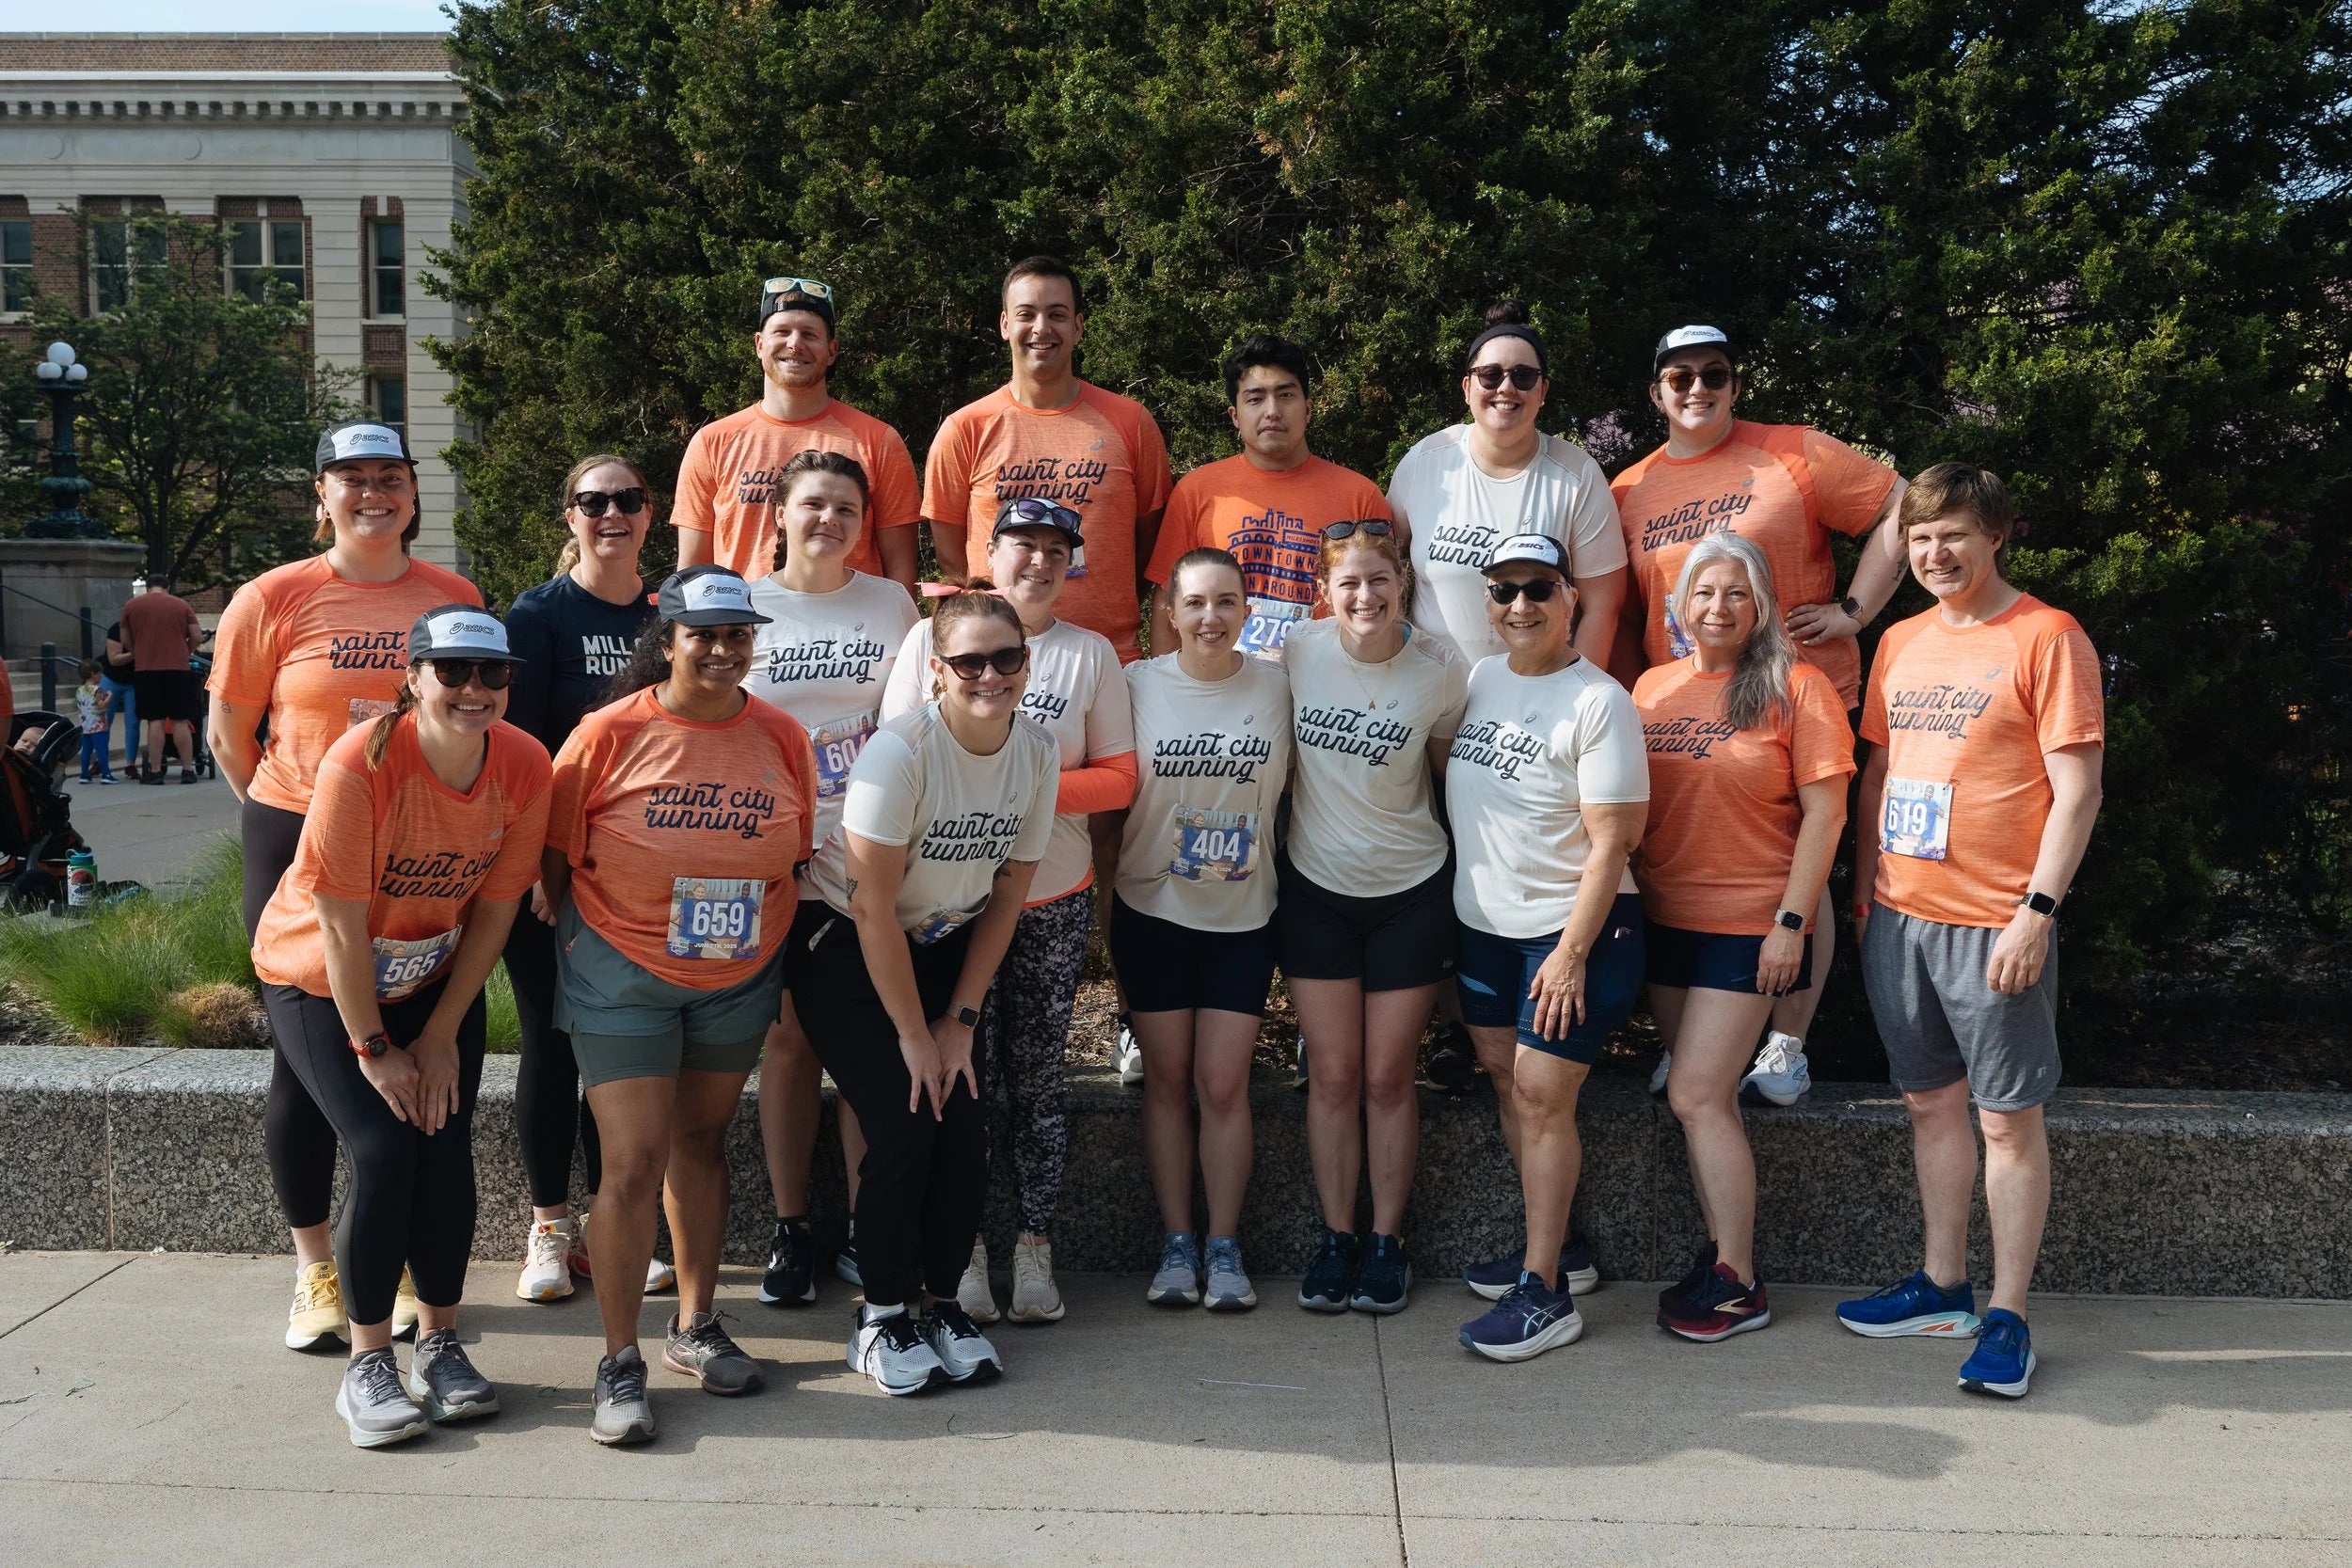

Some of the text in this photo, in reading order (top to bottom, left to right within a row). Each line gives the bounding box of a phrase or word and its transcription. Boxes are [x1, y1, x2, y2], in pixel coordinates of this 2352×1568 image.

[740, 466, 780, 485] sai
[997, 457, 1107, 484] saint city
[994, 479, 1093, 505] running
[1645, 494, 1752, 533] saint city
[1434, 524, 1500, 548] saint
[1641, 514, 1737, 552] running
[1428, 542, 1492, 569] runni
[1263, 578, 1311, 600] AROUND
[331, 631, 406, 651] saint
[581, 635, 633, 656] MILL
[770, 639, 884, 665] saint city
[328, 649, 407, 670] runn
[768, 658, 876, 684] running
[1021, 689, 1069, 720] city
[1892, 684, 1994, 719] saint city
[1299, 705, 1413, 751] saint city
[1694, 718, 1739, 741] city
[1888, 709, 1967, 739] running
[1154, 733, 1271, 765] saint city
[1296, 722, 1390, 767] running
[1500, 731, 1545, 765] city
[1645, 734, 1714, 759] nning
[1152, 755, 1256, 784] running
[1449, 742, 1520, 782] unning
[648, 782, 775, 819] saint city
[644, 806, 764, 839] running
[928, 812, 995, 839] saint
[1887, 799, 1927, 836] 619
[920, 836, 1011, 865] running
[1191, 830, 1240, 862] 404
[384, 851, 465, 879] saint
[691, 900, 745, 937] 659
[383, 950, 439, 983] 565
